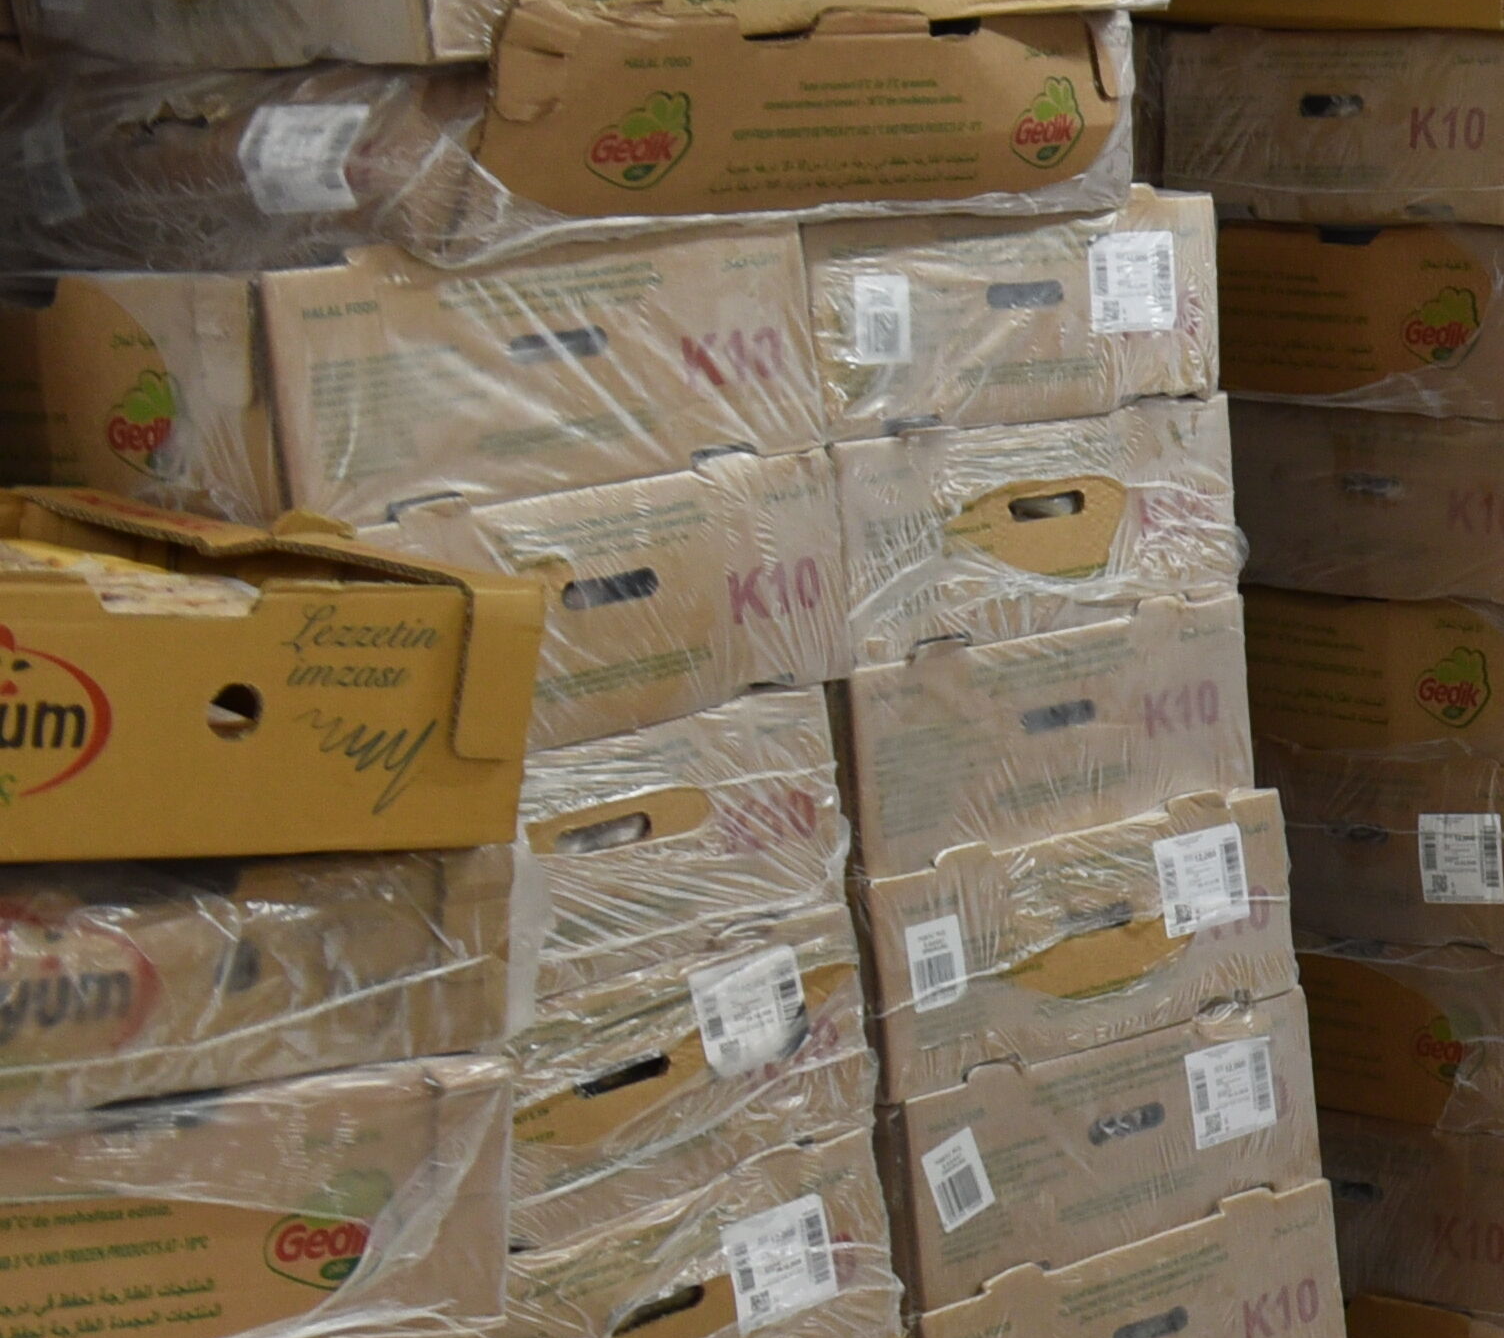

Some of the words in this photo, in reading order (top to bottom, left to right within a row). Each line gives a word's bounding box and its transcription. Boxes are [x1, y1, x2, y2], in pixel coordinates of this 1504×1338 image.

[1014, 111, 1078, 147] Gedik
[1408, 105, 1486, 152] K10
[728, 554, 822, 624] K10
[282, 603, 442, 653] Lezzetin
[1144, 680, 1220, 739] K10
[1418, 677, 1480, 711] Gedik
